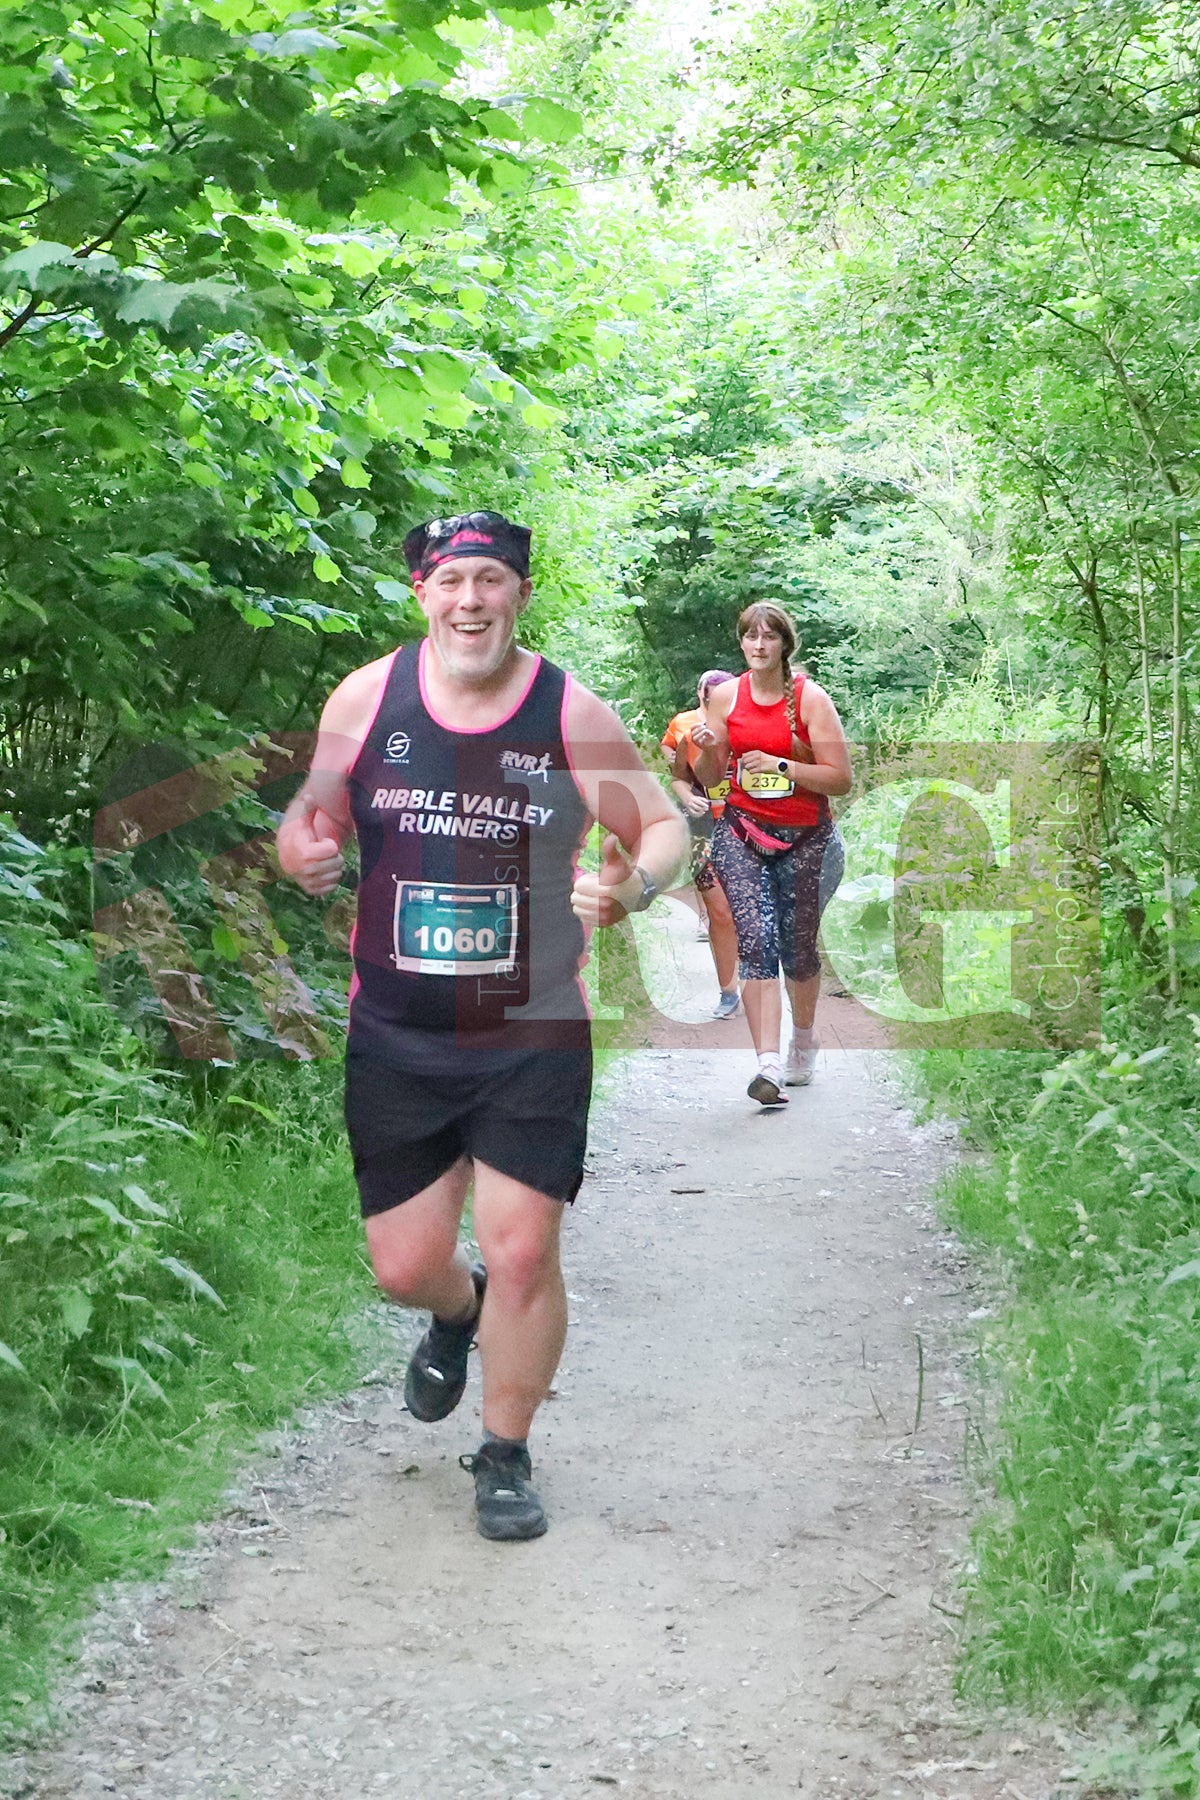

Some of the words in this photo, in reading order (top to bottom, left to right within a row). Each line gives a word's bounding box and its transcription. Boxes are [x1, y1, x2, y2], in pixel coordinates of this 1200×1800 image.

[500, 750, 538, 771] RVR
[751, 777, 780, 788] 237
[371, 788, 457, 813] RIBBLE
[462, 793, 554, 827] VALLEY
[399, 813, 519, 841] RUNNERS
[414, 925, 496, 954] 1060
